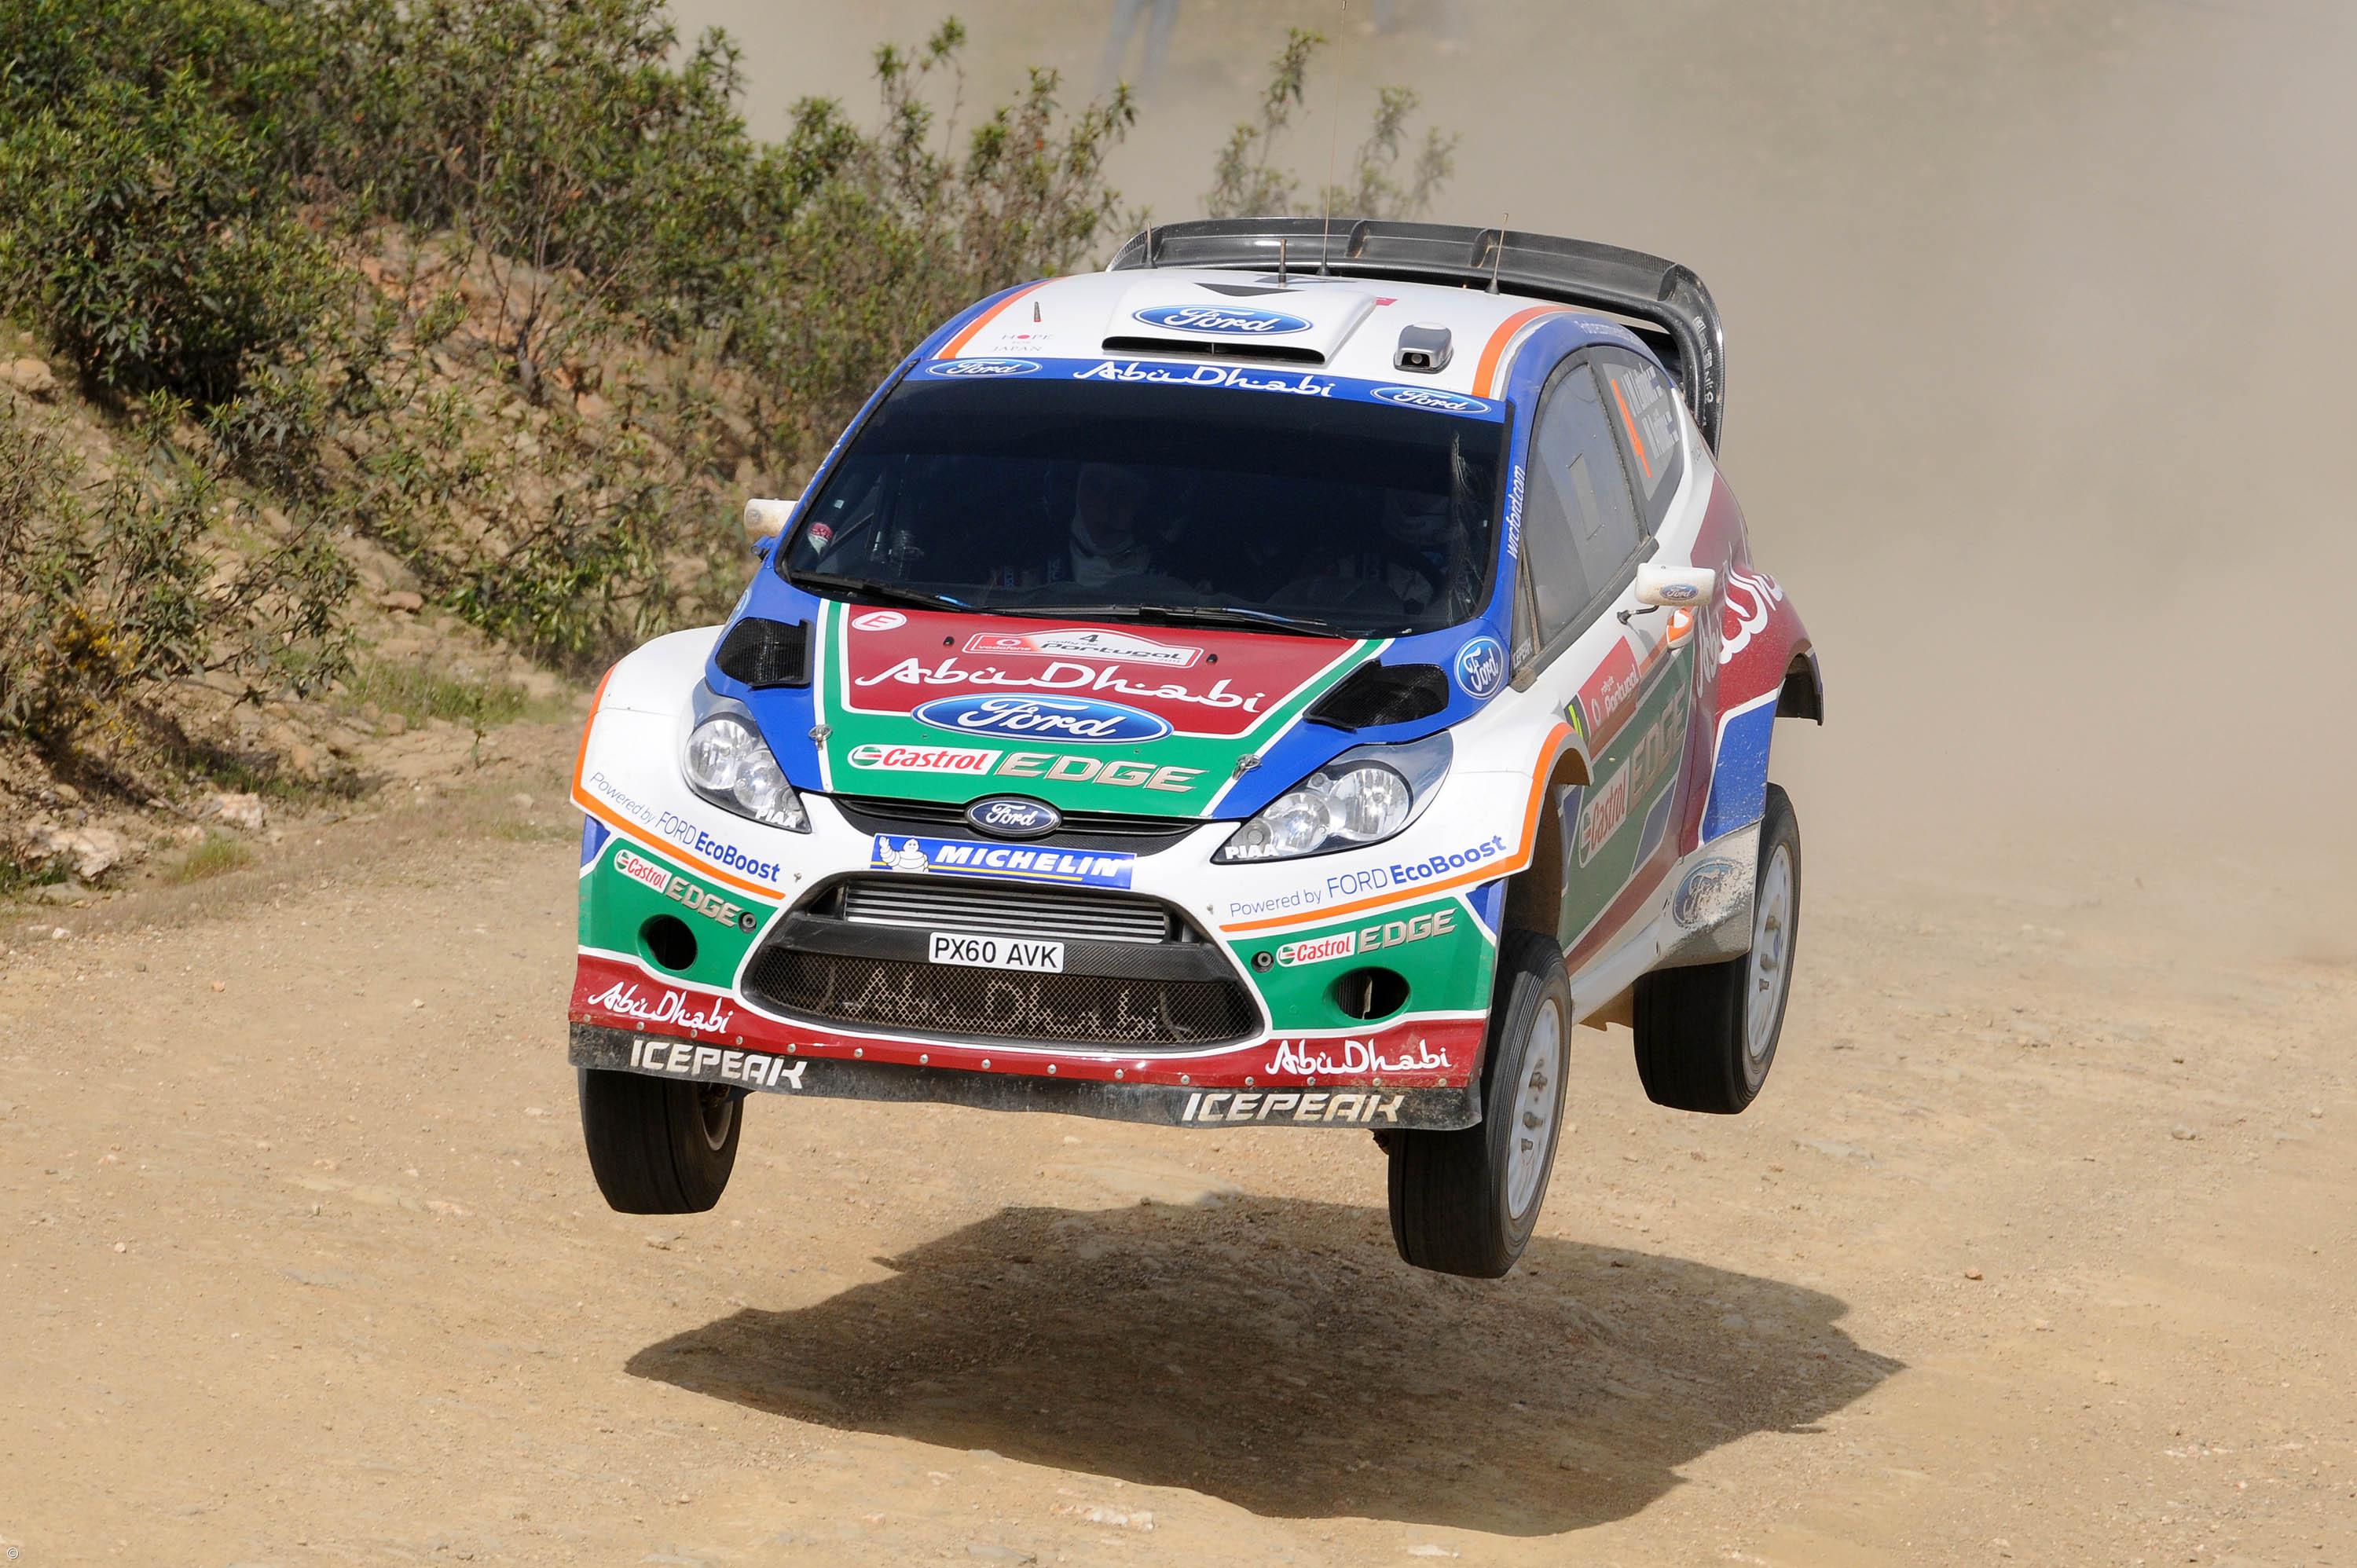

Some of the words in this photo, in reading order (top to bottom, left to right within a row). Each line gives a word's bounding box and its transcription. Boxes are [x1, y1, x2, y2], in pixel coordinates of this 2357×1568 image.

[1164, 307, 1281, 335] Ford
[946, 361, 1021, 374] Ford
[1385, 388, 1468, 412] Ford
[1507, 464, 1526, 559] wrcford.com
[1666, 584, 1692, 597] Ford
[871, 613, 897, 628] E
[1040, 643, 1183, 660] Portugal
[1079, 634, 1100, 643] 4
[1465, 647, 1498, 693] Ford
[958, 698, 1120, 737] Ford
[885, 746, 988, 772] Castrol
[995, 751, 1208, 792] EDGE
[1590, 770, 1626, 851] Castrol
[1629, 683, 1686, 813] EDGE
[590, 771, 645, 814] Powered
[641, 805, 655, 824] by
[654, 811, 696, 844] FORD
[695, 832, 781, 882] EcoBoost
[754, 809, 797, 828] PIAA
[985, 800, 1037, 828] Ford
[935, 845, 1124, 877] MICHELIN
[1225, 845, 1279, 860] PIAA
[1230, 893, 1301, 918] Powered
[1304, 888, 1321, 905] by
[1326, 868, 1388, 898] FORD
[1391, 834, 1507, 885] EcoBoost
[627, 857, 668, 890] Castrol
[665, 875, 743, 929] EDGE
[1296, 935, 1351, 963] Castrol
[1358, 907, 1459, 955] EDGE
[933, 938, 997, 963] PX60
[1006, 943, 1059, 969] AVK
[630, 1039, 808, 1090] ICEPEAK
[1182, 1093, 1406, 1123] ICEPEAK
